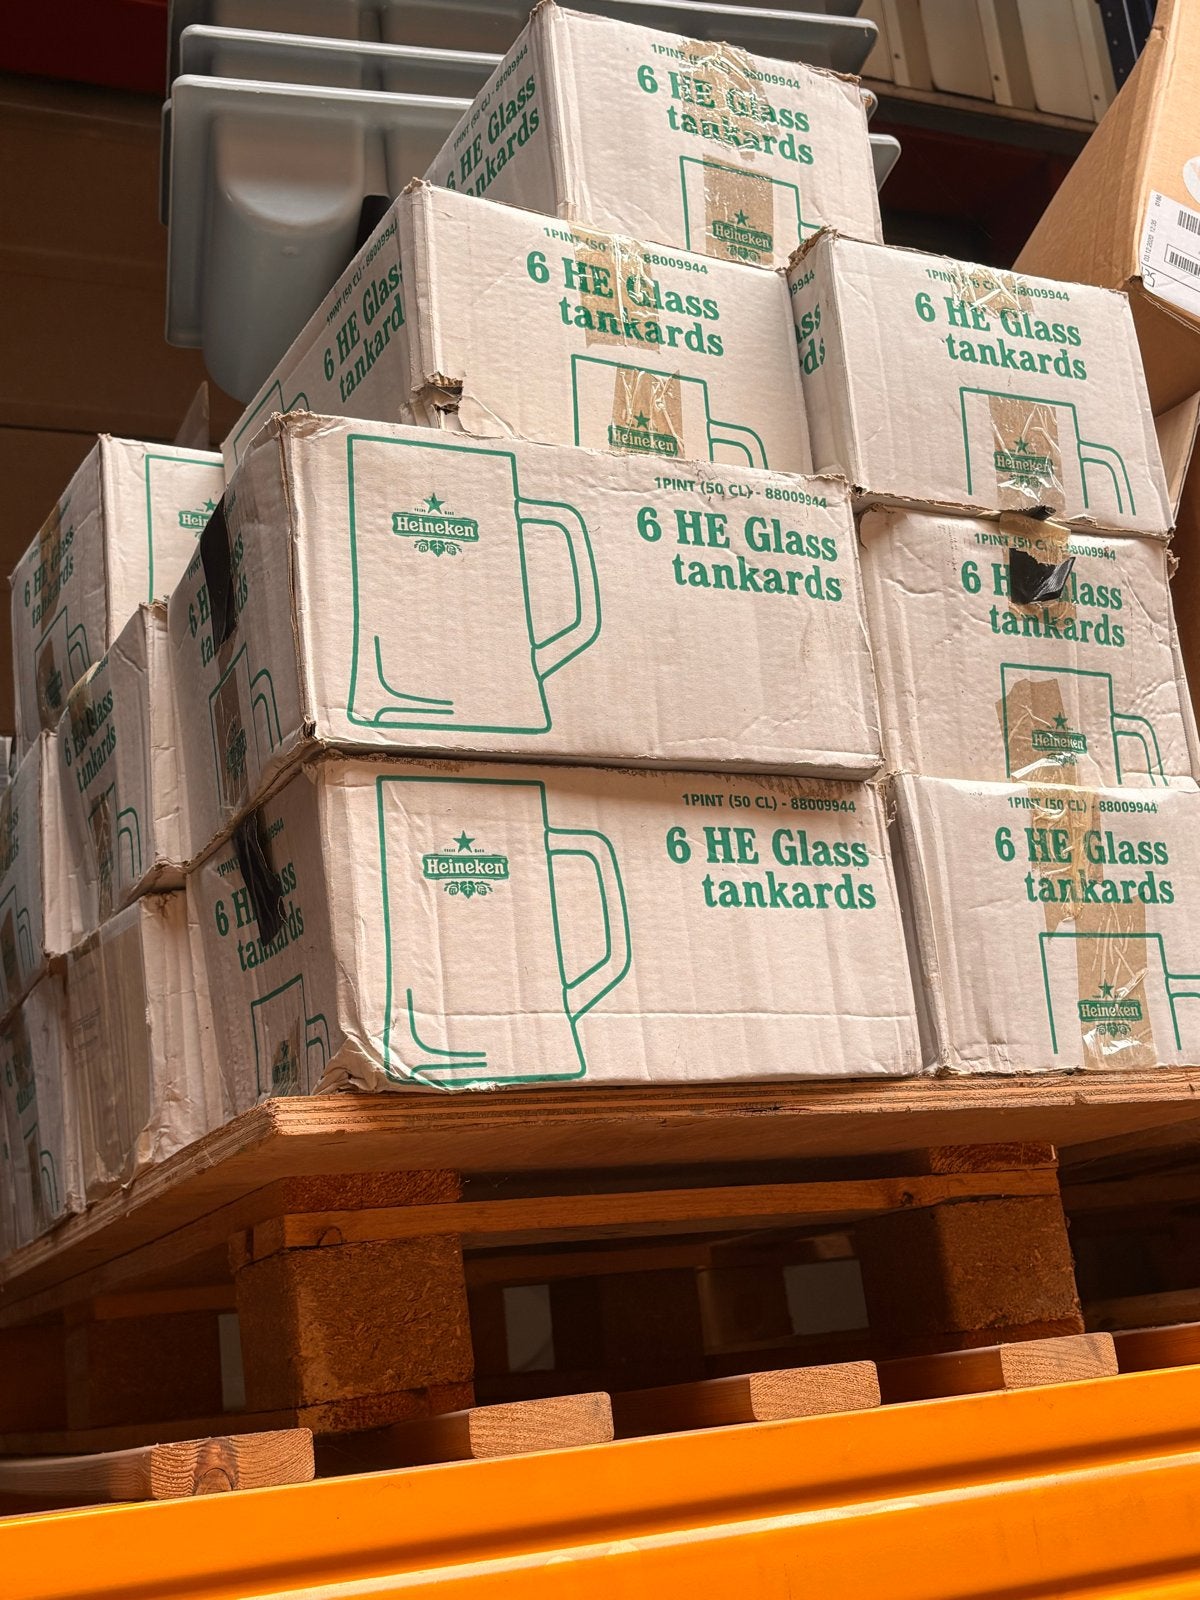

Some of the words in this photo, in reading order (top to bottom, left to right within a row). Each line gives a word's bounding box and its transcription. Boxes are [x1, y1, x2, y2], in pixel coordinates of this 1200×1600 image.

[636, 64, 658, 94] 6
[667, 71, 716, 109] HE
[725, 87, 810, 133] Glass
[459, 132, 483, 185] HE
[487, 74, 536, 145] Glass
[666, 105, 814, 166] tankards
[465, 107, 540, 198] ankards
[715, 224, 770, 248] Heineken
[643, 253, 709, 275] 88009944
[526, 250, 550, 284] 6
[561, 256, 614, 299] HE
[626, 273, 720, 321] Glass
[558, 296, 725, 357] tankards
[914, 292, 936, 323] 6
[944, 296, 991, 332] HE
[1000, 308, 1082, 347] Glass
[323, 347, 335, 381] 6
[335, 310, 361, 365] HE
[945, 332, 1087, 381] tankards
[612, 427, 674, 452] Heineken
[996, 455, 1050, 473] Heineken
[654, 476, 696, 492] 1PINT
[700, 480, 725, 496] (50
[728, 484, 751, 499] CL)
[765, 488, 827, 509] 88009944
[396, 516, 475, 537] Heineken
[636, 506, 662, 543] 6
[673, 509, 730, 549] HE
[744, 516, 838, 562] Glass
[974, 532, 1009, 547] 1PINT
[24, 580, 31, 608] 6
[671, 553, 843, 602] tankards
[961, 560, 982, 594] 6
[990, 562, 1010, 597] H
[1058, 572, 1123, 611] lass
[188, 603, 198, 639] 6
[989, 604, 1126, 648] tankards
[64, 737, 72, 767] 6
[76, 723, 117, 794] tankards
[1033, 733, 1084, 750] Heineken
[682, 793, 724, 807] 1PINT
[729, 794, 751, 809] (50
[755, 796, 778, 811] CL)
[791, 798, 857, 813] 88009944
[1007, 796, 1041, 809] 1PINT
[1045, 798, 1064, 811] (50
[1068, 799, 1087, 813] CL)
[1099, 800, 1158, 814] 88009944
[666, 826, 692, 864] 6
[702, 826, 759, 865] HE
[772, 828, 870, 867] Glass
[994, 826, 1016, 862] 6
[1024, 827, 1072, 864] HE
[1083, 830, 1169, 866] Glass
[426, 858, 506, 875] Heineken
[702, 871, 877, 909] tankards
[1024, 868, 1175, 905] tankards
[215, 900, 230, 937] 6
[231, 886, 258, 929] H
[1080, 1003, 1139, 1018] Heineken
